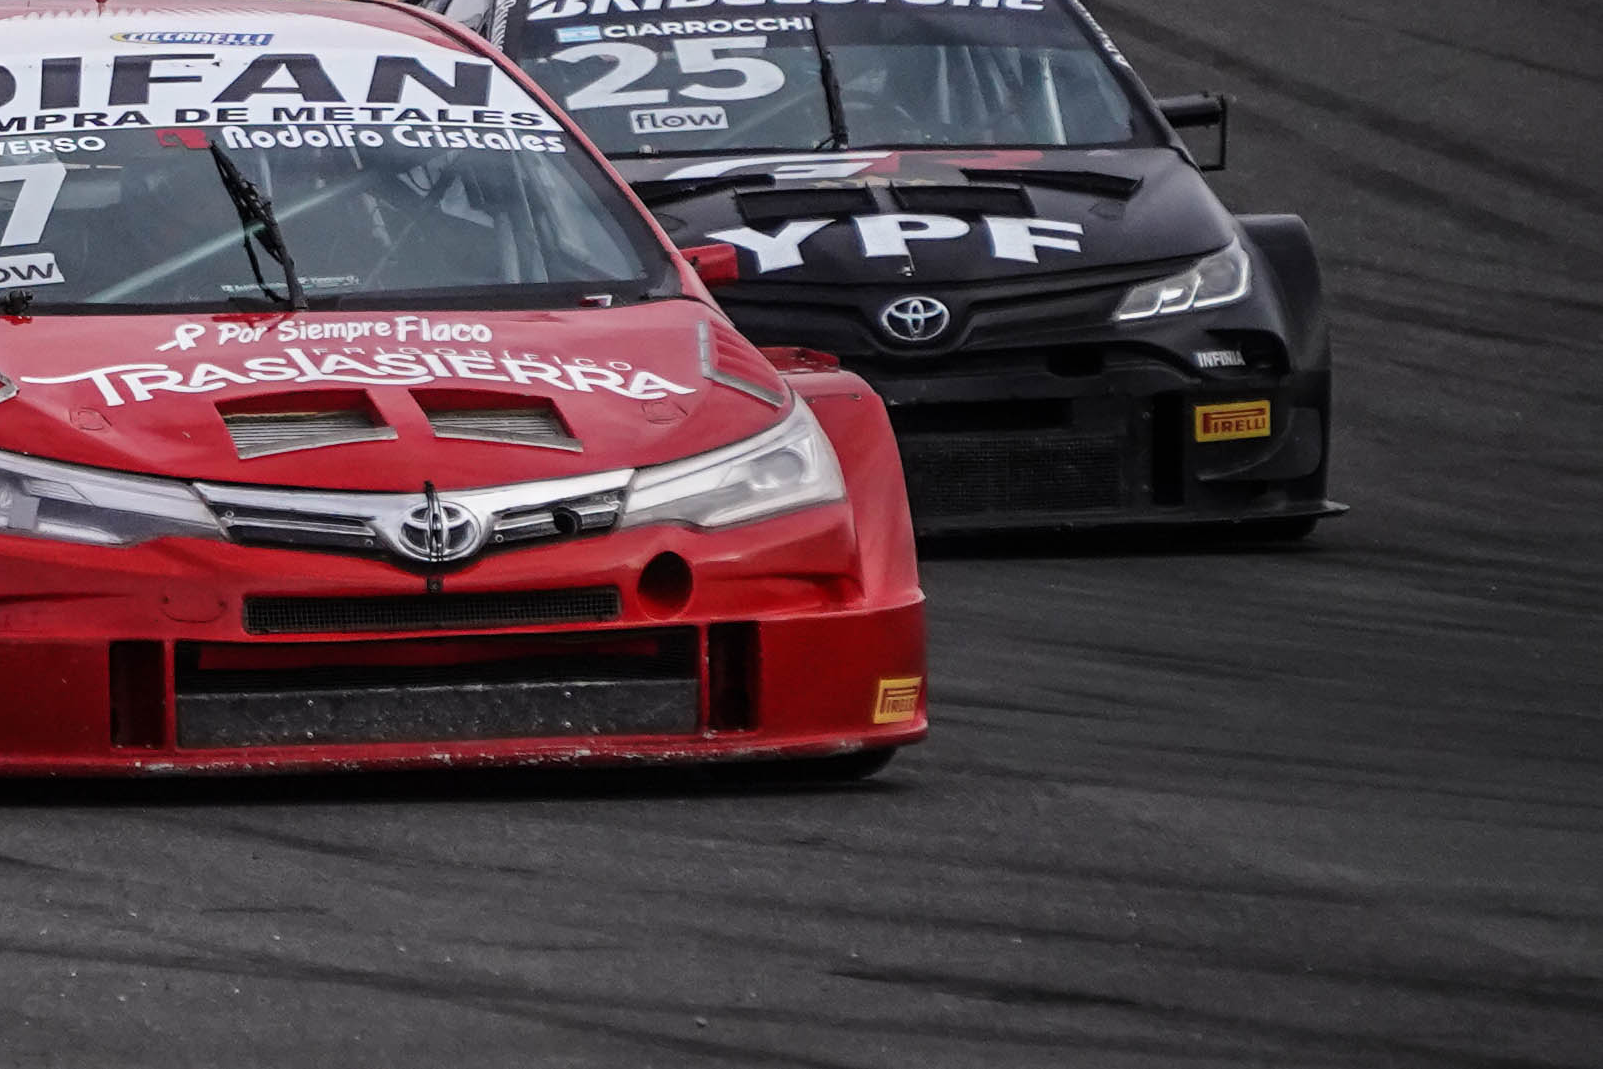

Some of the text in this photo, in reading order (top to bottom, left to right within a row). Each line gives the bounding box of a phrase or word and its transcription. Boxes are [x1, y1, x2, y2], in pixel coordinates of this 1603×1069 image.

[604, 15, 814, 39] CIARROCCHI
[552, 35, 785, 110] 25
[175, 108, 249, 123] DE
[273, 107, 543, 126] METALES
[636, 111, 723, 131] flow
[222, 124, 567, 154] Rodolfo Cristales
[706, 213, 1085, 274] YPF
[218, 316, 494, 345] Por Siempre Flaco
[19, 348, 698, 407] TRASLASIERRA
[1202, 408, 1266, 435] PIRELLI
